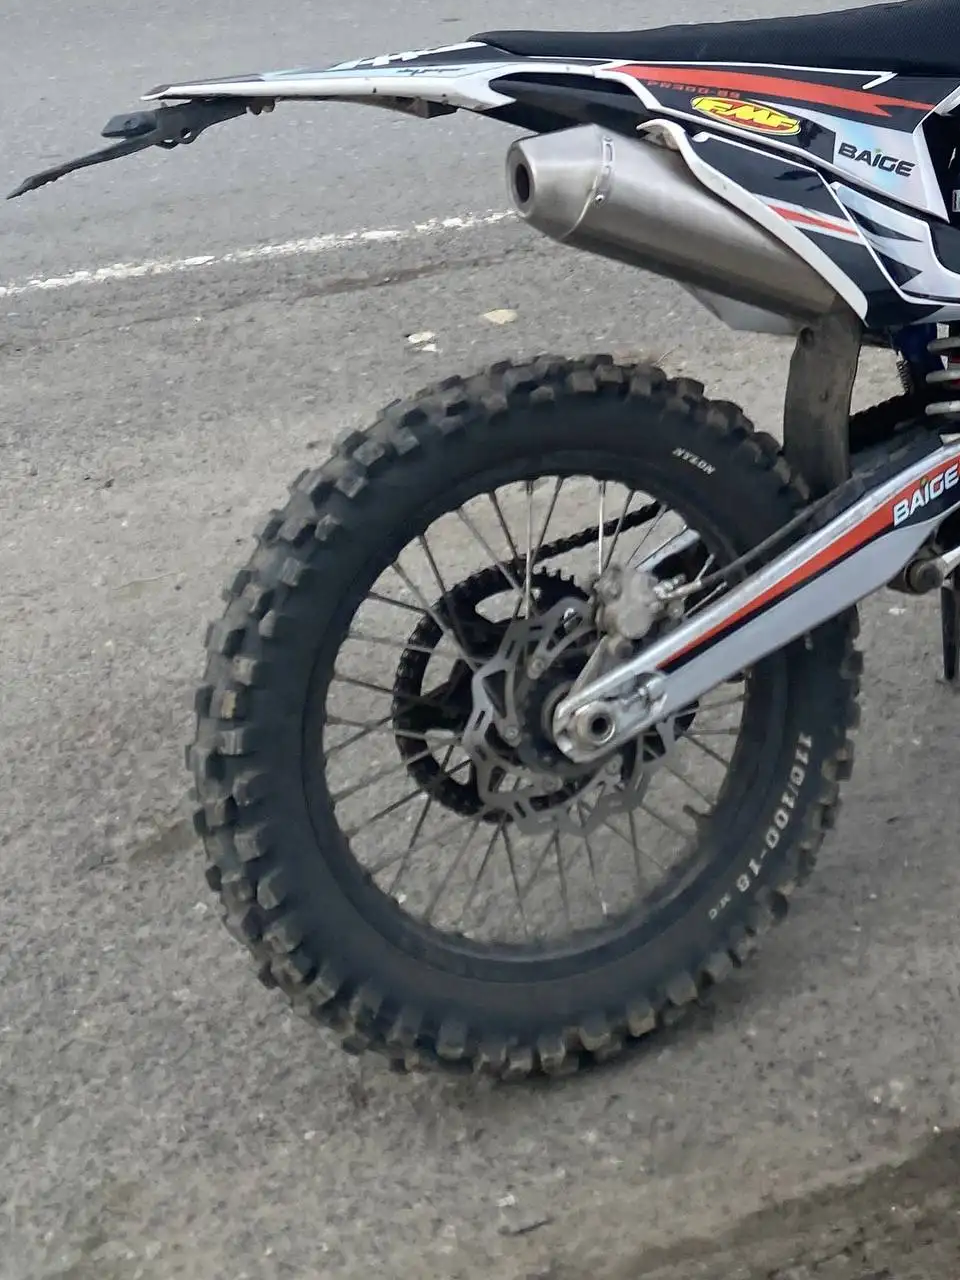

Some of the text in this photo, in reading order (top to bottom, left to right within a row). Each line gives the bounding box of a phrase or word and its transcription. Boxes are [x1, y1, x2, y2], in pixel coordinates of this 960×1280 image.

[694, 98, 798, 128] FMF
[838, 142, 916, 177] BAIGE
[672, 447, 716, 475] NYLON
[893, 463, 960, 527] BAIGE
[735, 732, 813, 893] 110/100-18
